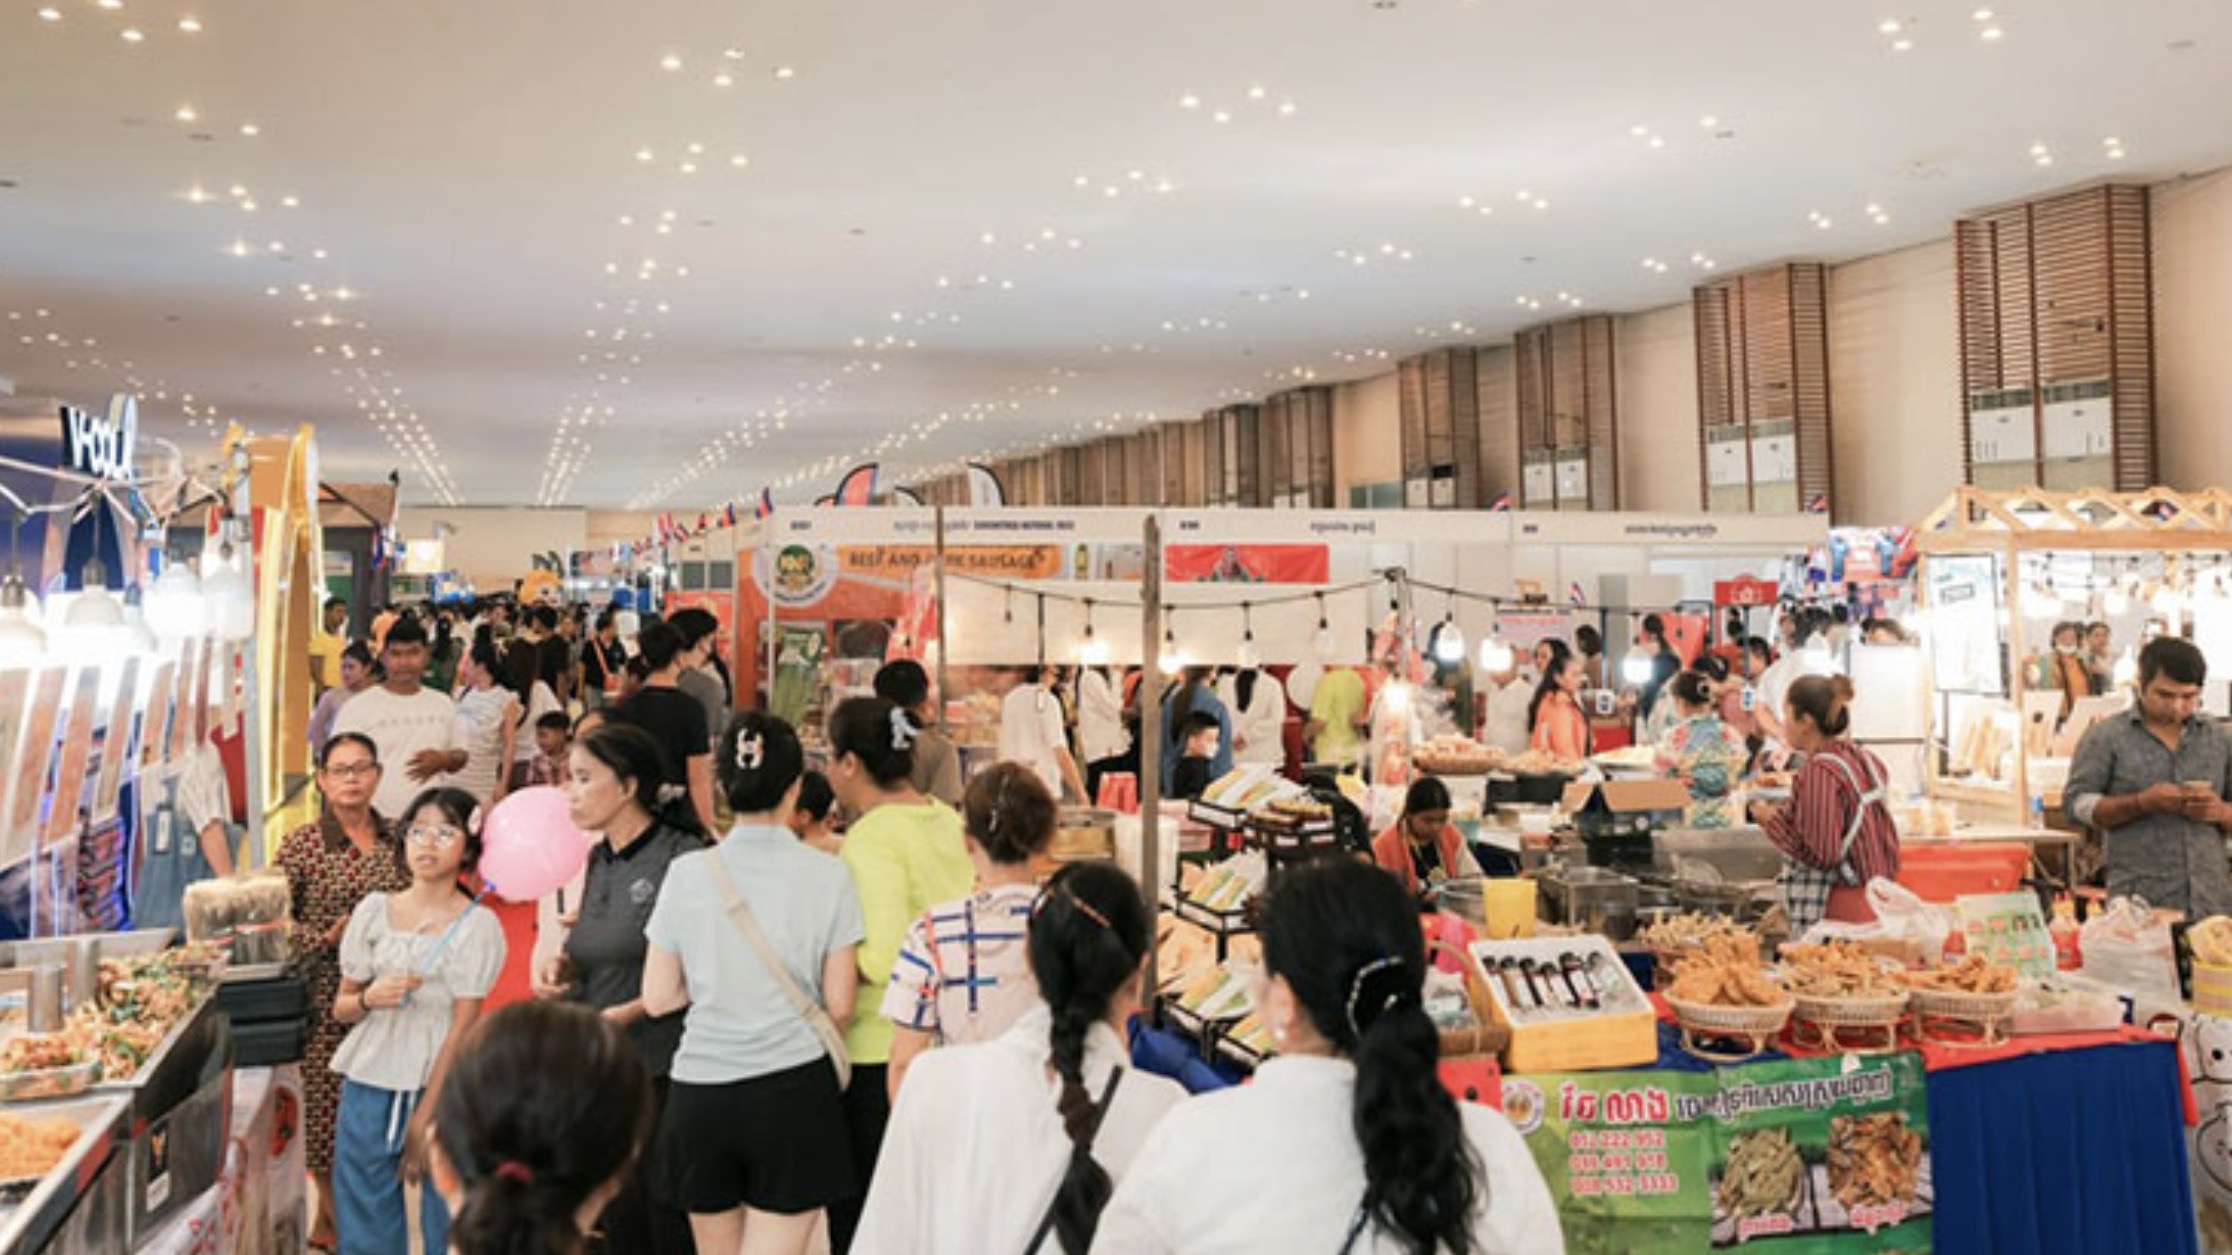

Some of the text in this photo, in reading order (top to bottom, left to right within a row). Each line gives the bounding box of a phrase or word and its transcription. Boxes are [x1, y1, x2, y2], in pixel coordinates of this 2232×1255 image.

[850, 546, 884, 568] BEEF
[888, 551, 920, 569] AND
[968, 547, 1046, 570] SAUSAGE
